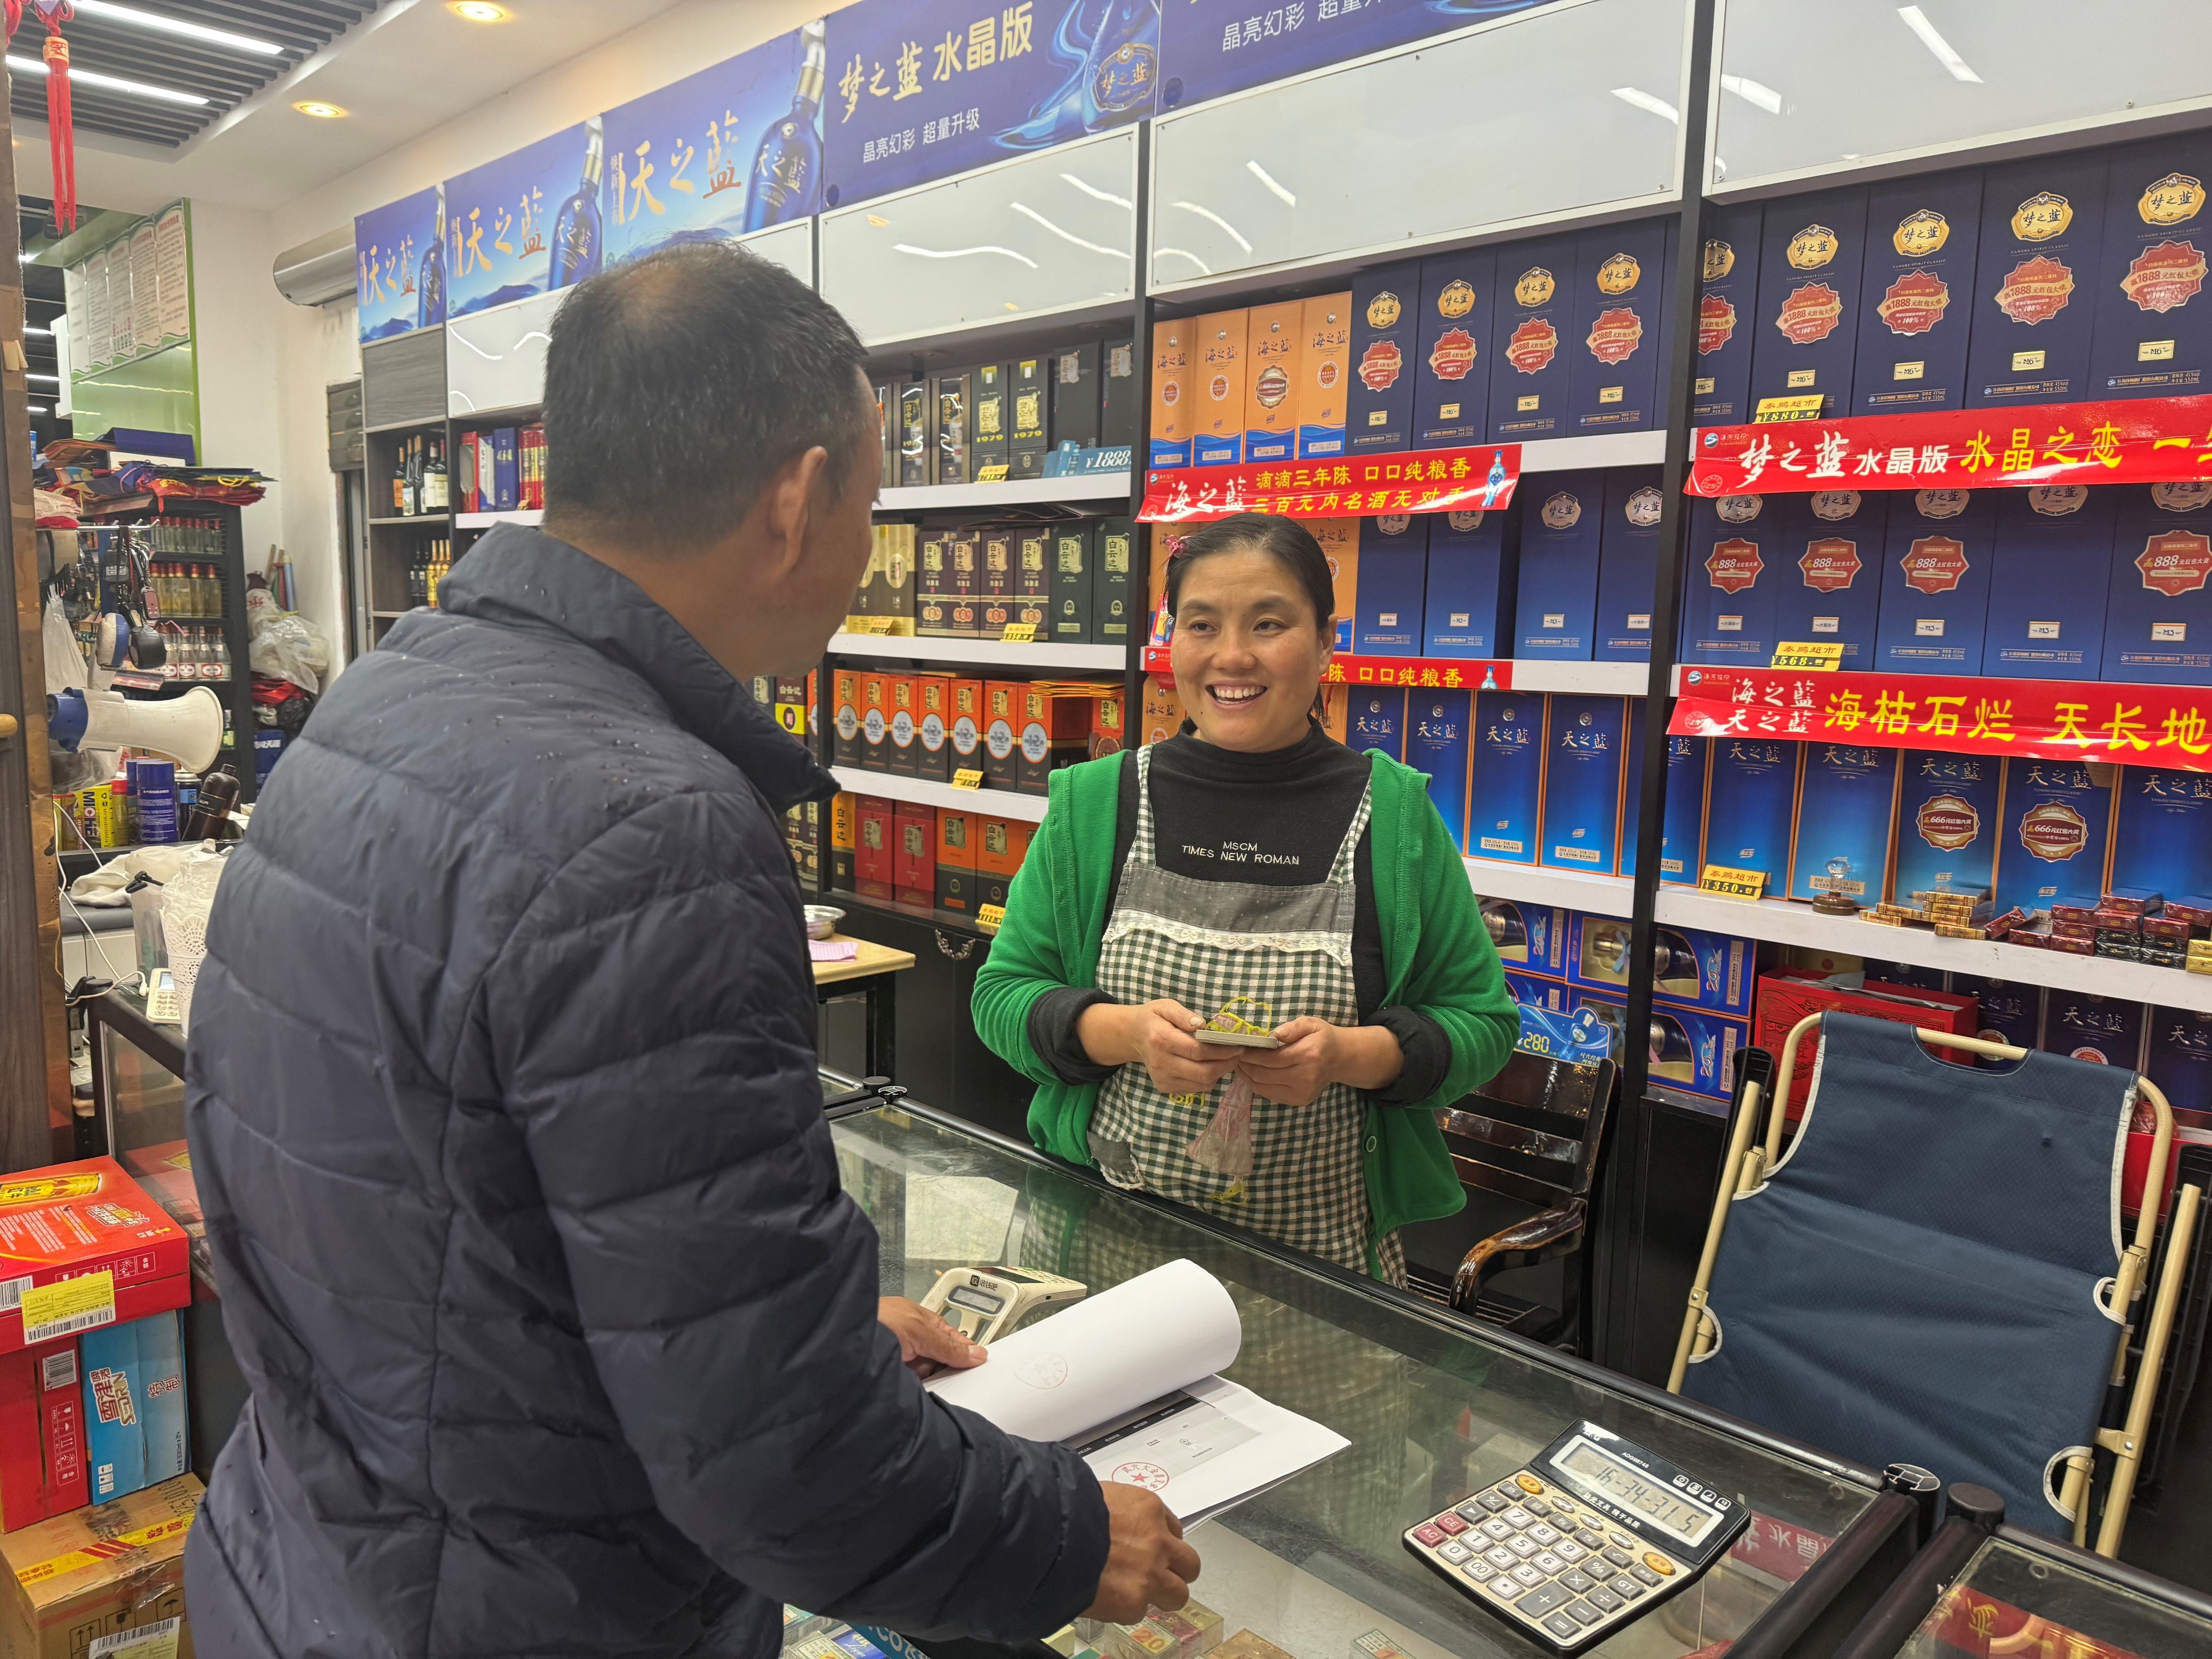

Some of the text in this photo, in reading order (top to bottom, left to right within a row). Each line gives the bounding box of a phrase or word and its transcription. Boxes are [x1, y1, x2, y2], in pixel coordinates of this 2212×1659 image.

[1222, 3, 1305, 52] 晶亮幻彩
[838, 41, 923, 124] 梦之蓝
[933, 2, 1033, 82] 水晶版
[863, 107, 980, 164] 晶亮幻彩 超量升级
[2150, 191, 2194, 211] 梦之蓝
[2023, 208, 2061, 229] 梦之蓝
[1903, 226, 1939, 244] 梦之蓝
[1796, 240, 1830, 258] 梦之蓝
[1705, 254, 1726, 267] 之蓝
[1604, 267, 1633, 284] 梦之蓝
[1522, 280, 1548, 296] 梦之蓝
[1763, 399, 1818, 410] 泰鹏超市
[1735, 429, 1846, 489] 梦之蓝
[1856, 443, 1949, 475] 水晶版
[1965, 421, 2123, 471] 水晶之恋
[1256, 465, 1352, 489] 滴滴三年陈
[1365, 456, 1472, 481] 口口纯粮香
[1724, 498, 1754, 512] 梦之蓝
[1821, 494, 1851, 508] 梦之蓝
[1783, 645, 1837, 654] 泰鹏超市
[1360, 666, 1464, 688] 口口纯粮香
[1825, 688, 2017, 742] 海枯石烂
[2043, 701, 2211, 755] 天长地
[1223, 841, 1257, 852] MSCM
[1182, 845, 1299, 865] TIMES NEW ROMAN
[1709, 870, 1759, 883] 泰鹏超市
[980, 1279, 998, 1291] 收钱吧
[148, 1375, 180, 1398] 特制
[94, 1379, 119, 1422] 雪津
[114, 1371, 136, 1425] SEDRIN
[1444, 1517, 1459, 1527] CE
[1422, 1528, 1438, 1538] AC
[1537, 1527, 1549, 1536] 8
[1494, 1551, 1507, 1560] 2
[1471, 1562, 1488, 1573] 00
[1592, 1562, 1604, 1573] %
[1618, 1580, 1635, 1591] GT
